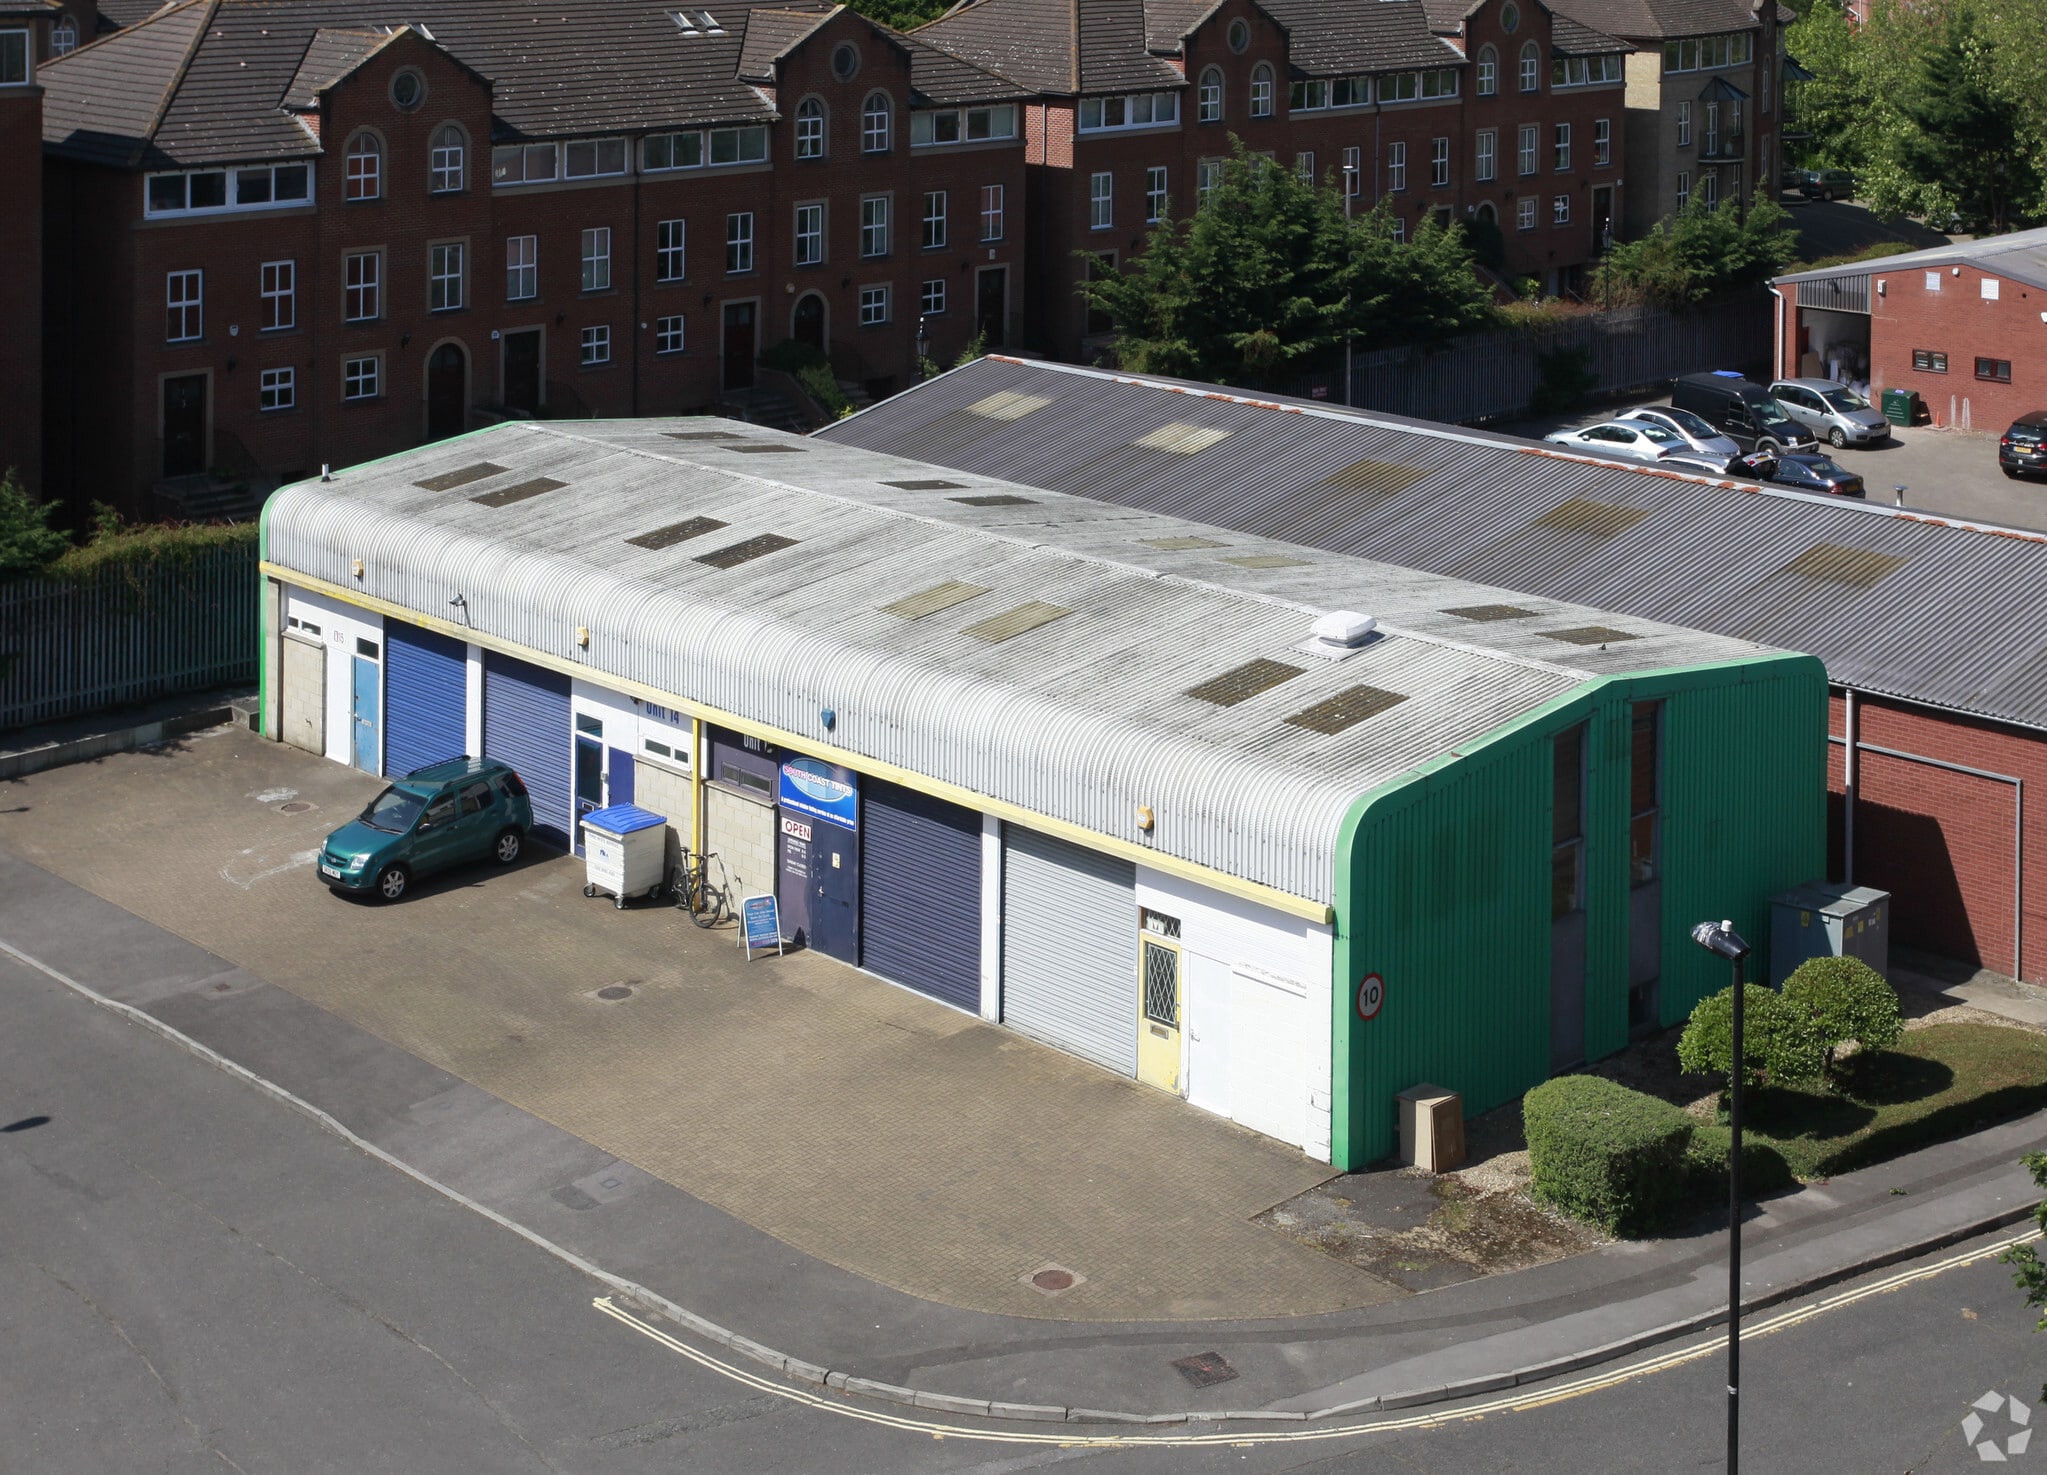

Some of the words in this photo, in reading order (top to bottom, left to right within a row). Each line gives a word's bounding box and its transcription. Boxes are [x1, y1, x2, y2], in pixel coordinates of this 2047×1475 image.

[783, 765, 807, 779] SOUTH
[808, 773, 830, 787] COAST
[832, 780, 853, 795] TINTS
[785, 821, 810, 839] OPEN
[1363, 986, 1379, 1007] 10
